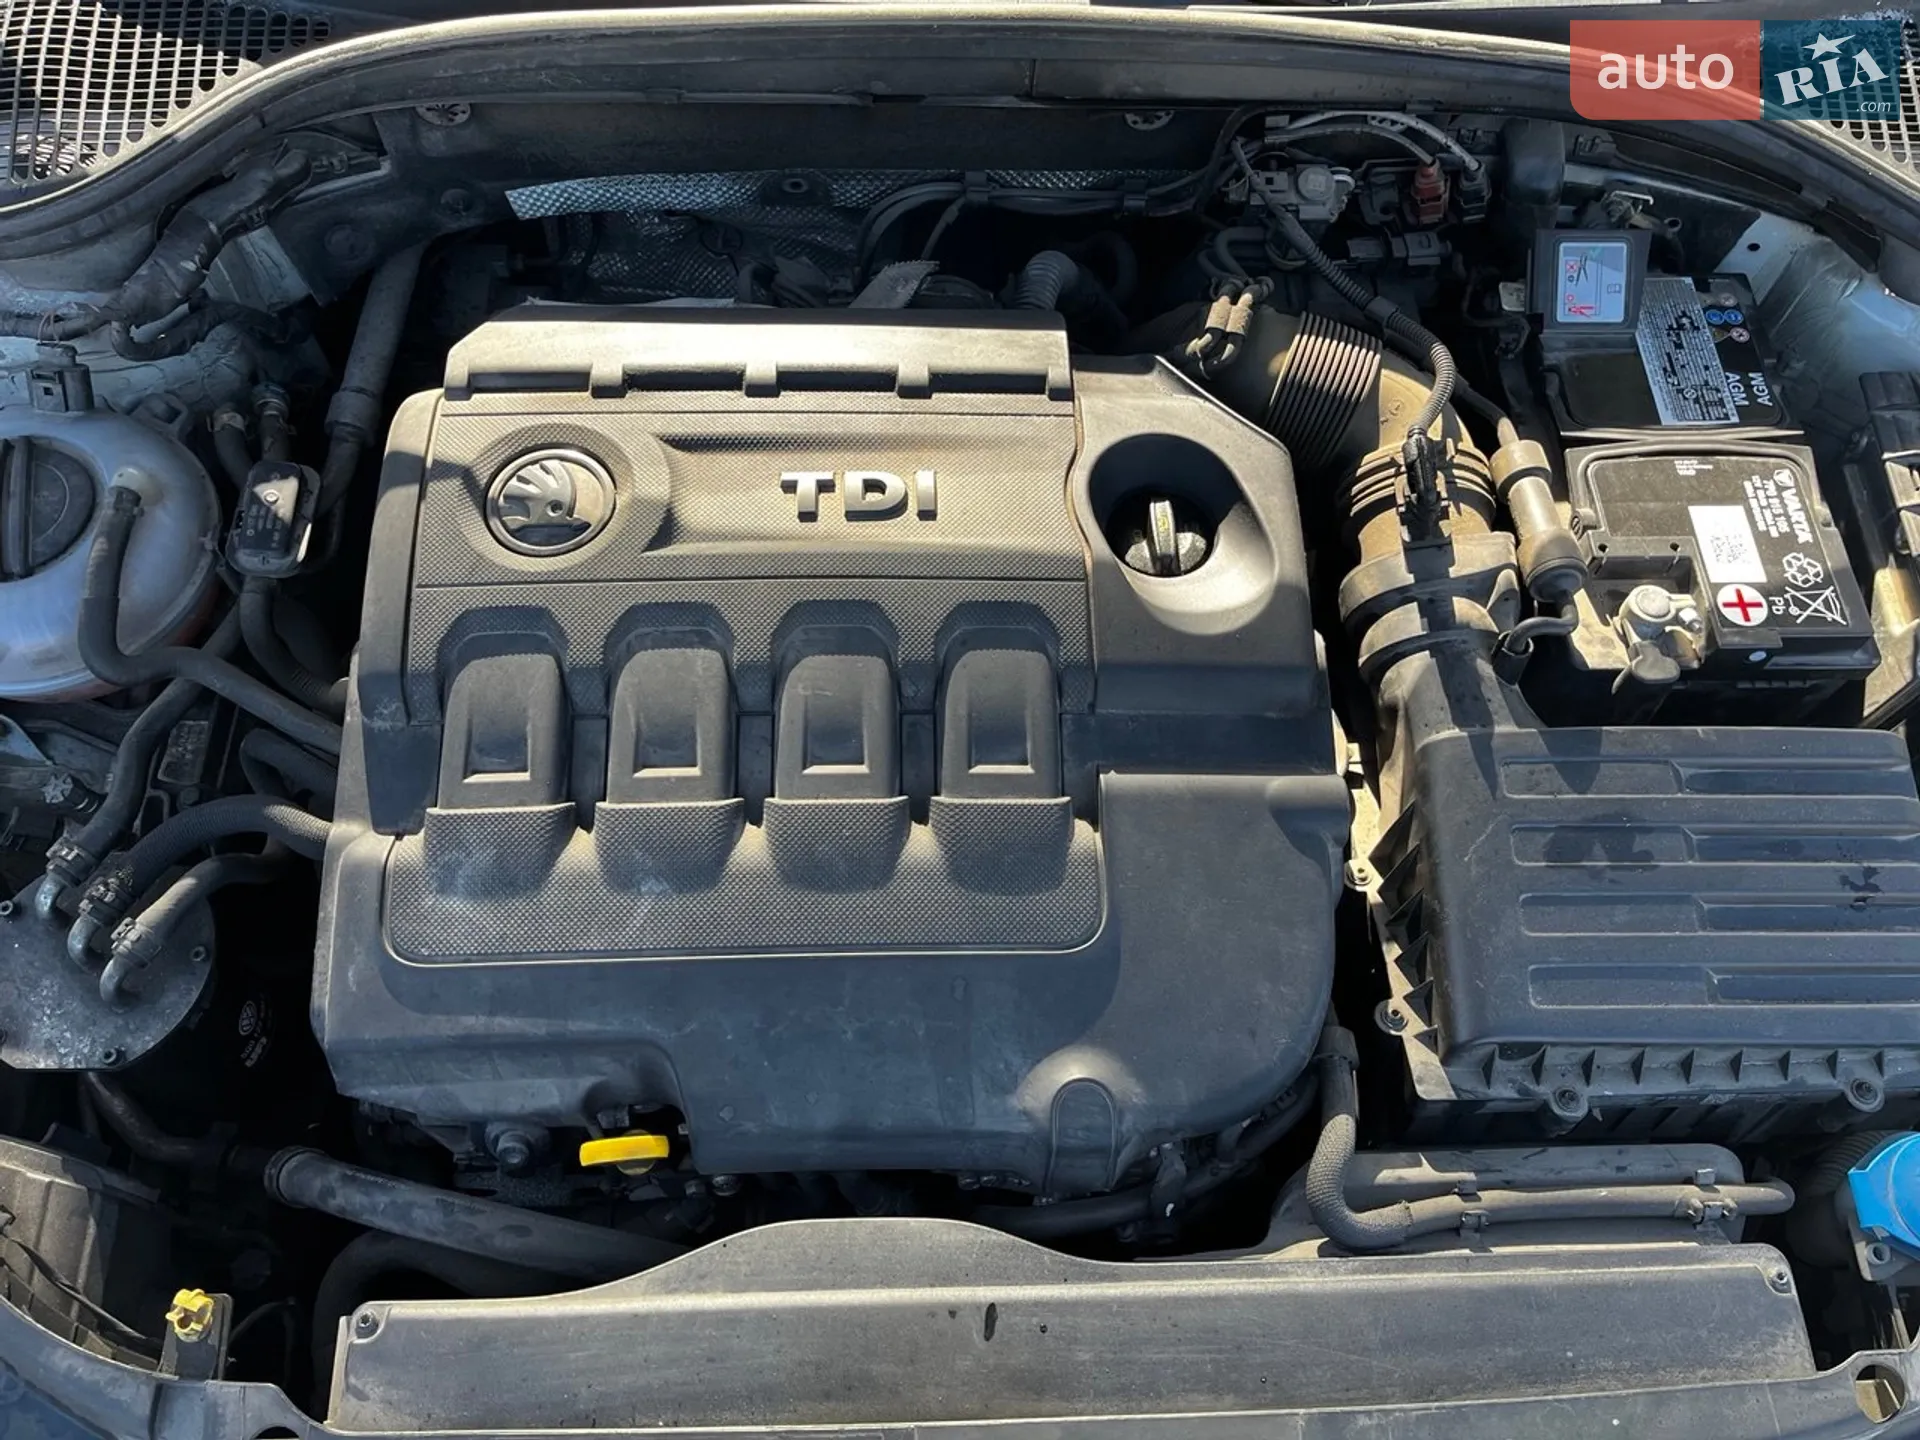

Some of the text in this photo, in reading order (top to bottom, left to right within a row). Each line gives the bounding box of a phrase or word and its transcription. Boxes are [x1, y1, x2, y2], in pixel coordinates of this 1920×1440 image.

[1725, 372, 1750, 406] AGM
[780, 470, 938, 522] TDI
[1781, 487, 1814, 545] VARTA
[1769, 596, 1786, 615] Pb
